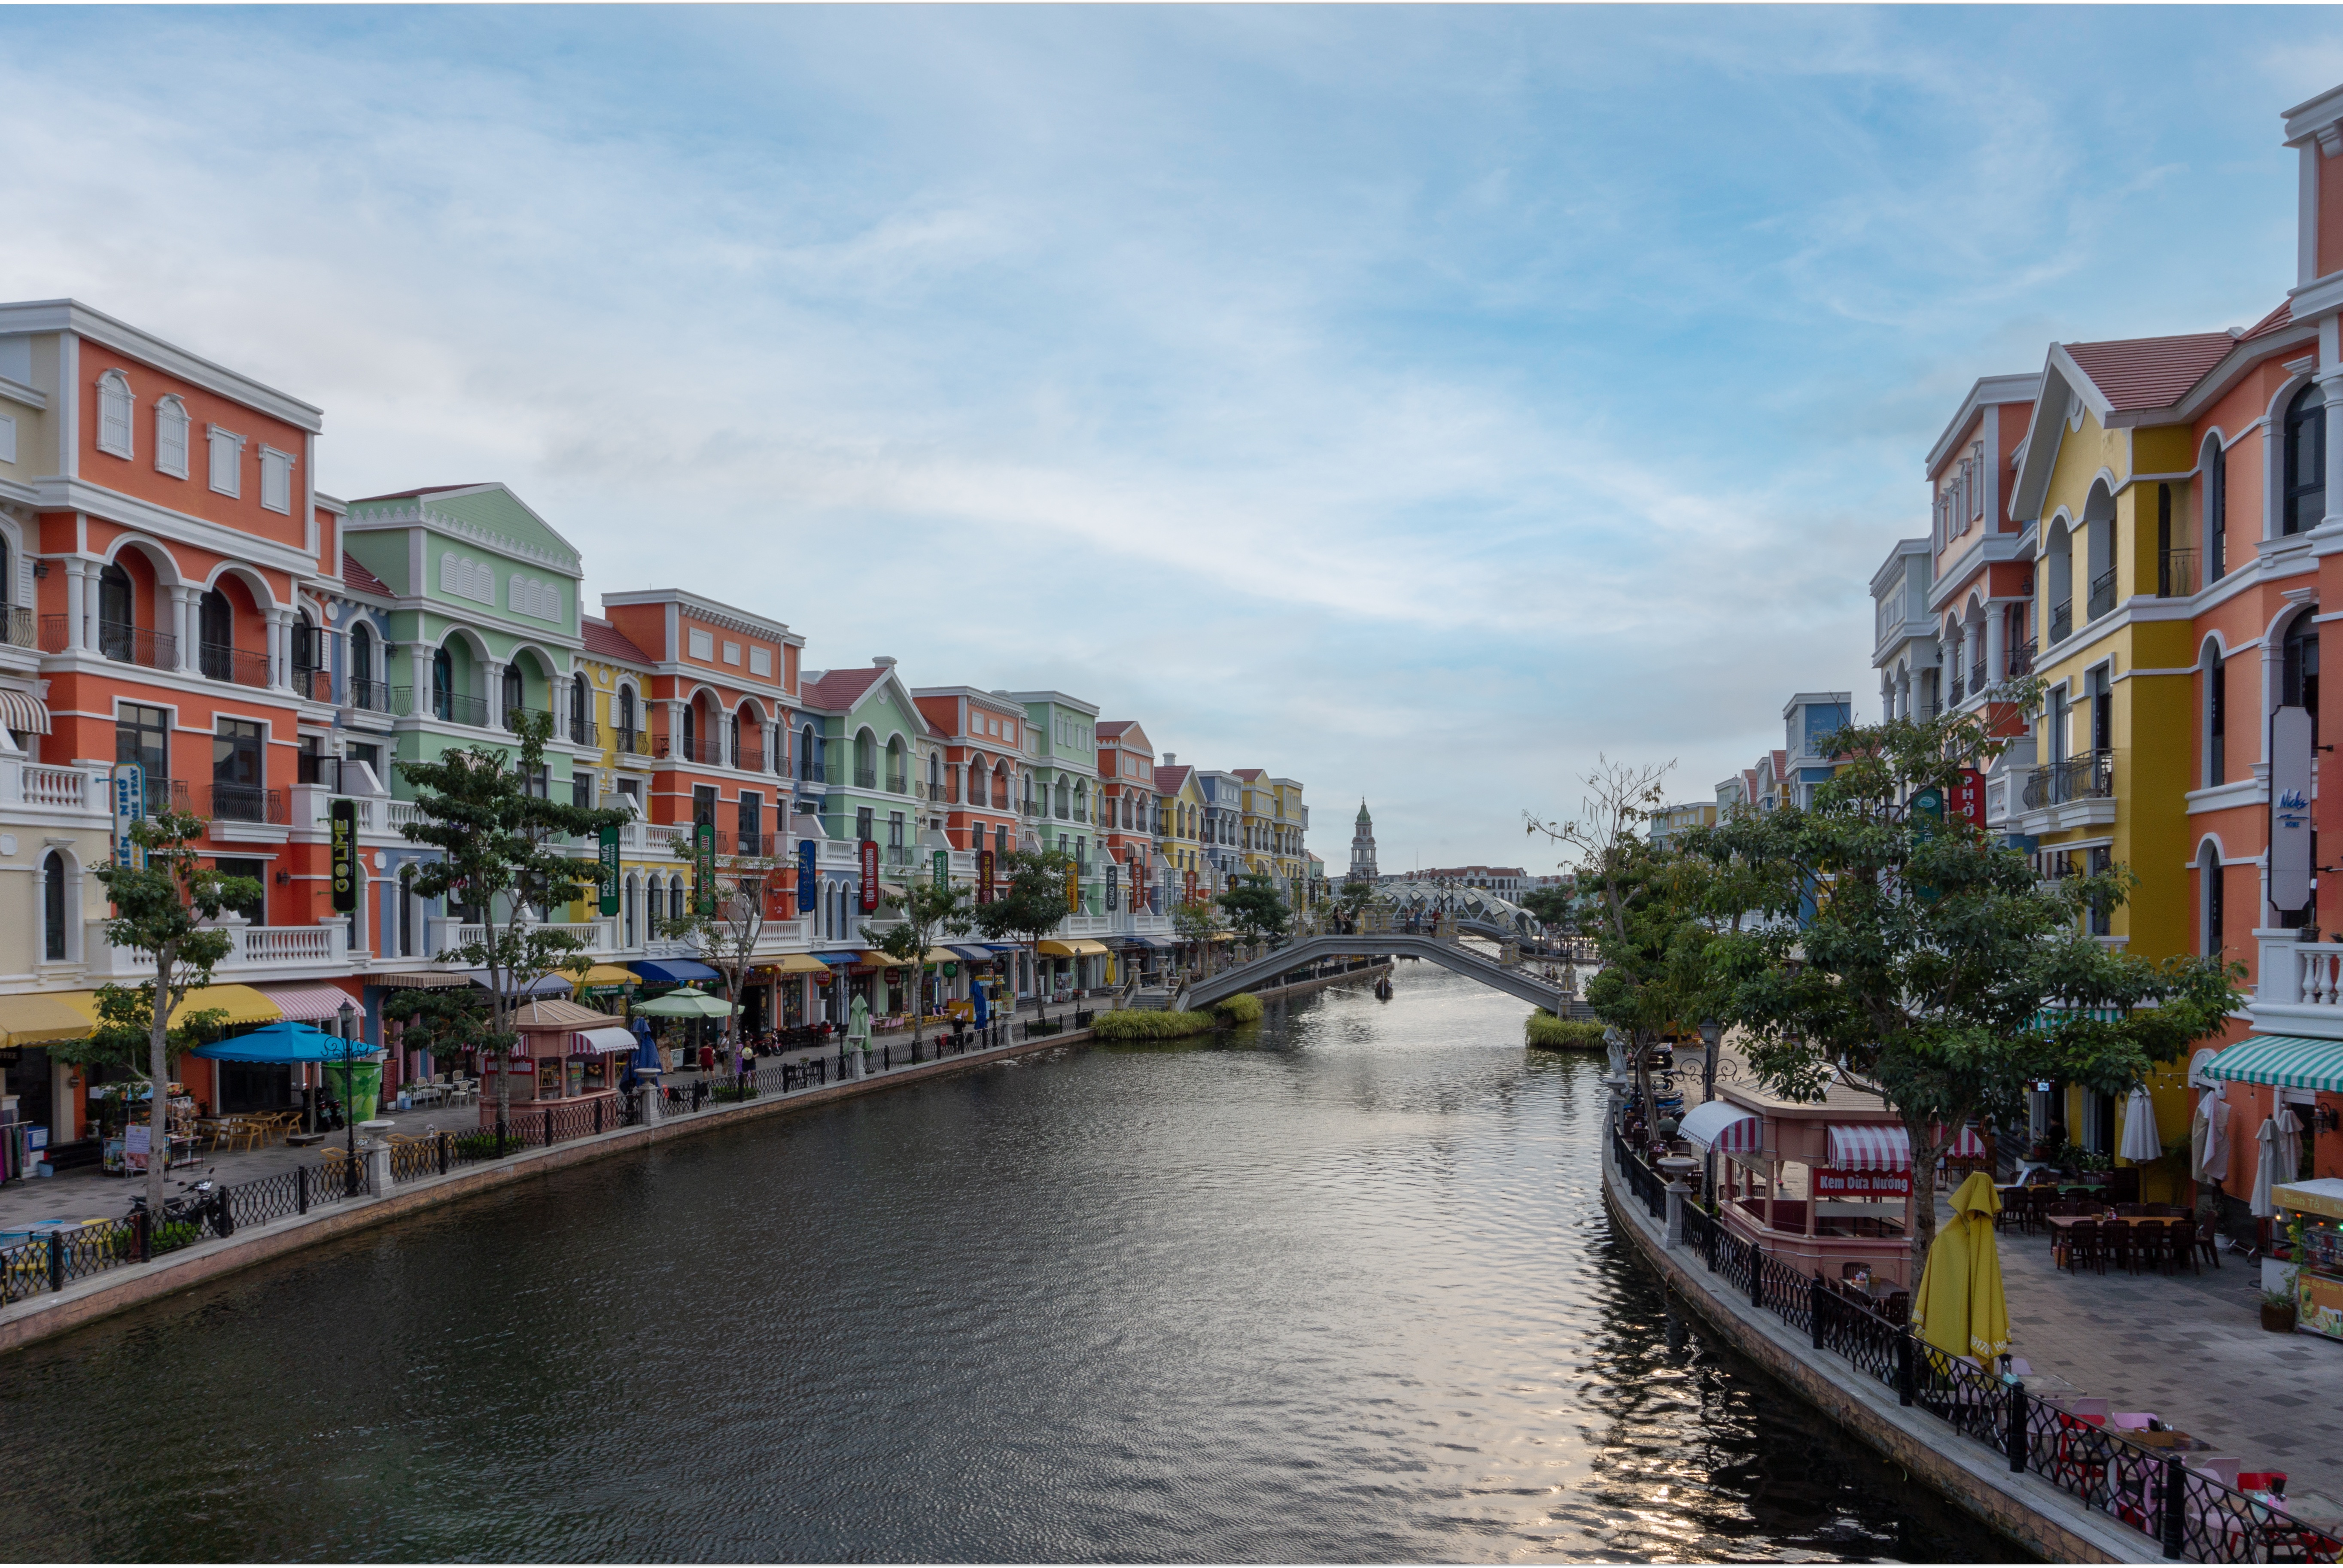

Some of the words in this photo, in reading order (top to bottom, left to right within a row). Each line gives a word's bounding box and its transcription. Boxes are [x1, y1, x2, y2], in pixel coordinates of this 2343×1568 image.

[131, 767, 139, 796] STAY
[601, 844, 610, 862] MÍA
[866, 848, 874, 876] HONGKONG
[1820, 1176, 1844, 1189] Kem
[1847, 1174, 1869, 1189] Dừa
[1872, 1174, 1908, 1192] Nướng
[2284, 1193, 2305, 1206] Sinh
[2308, 1196, 2320, 1209] Tố
